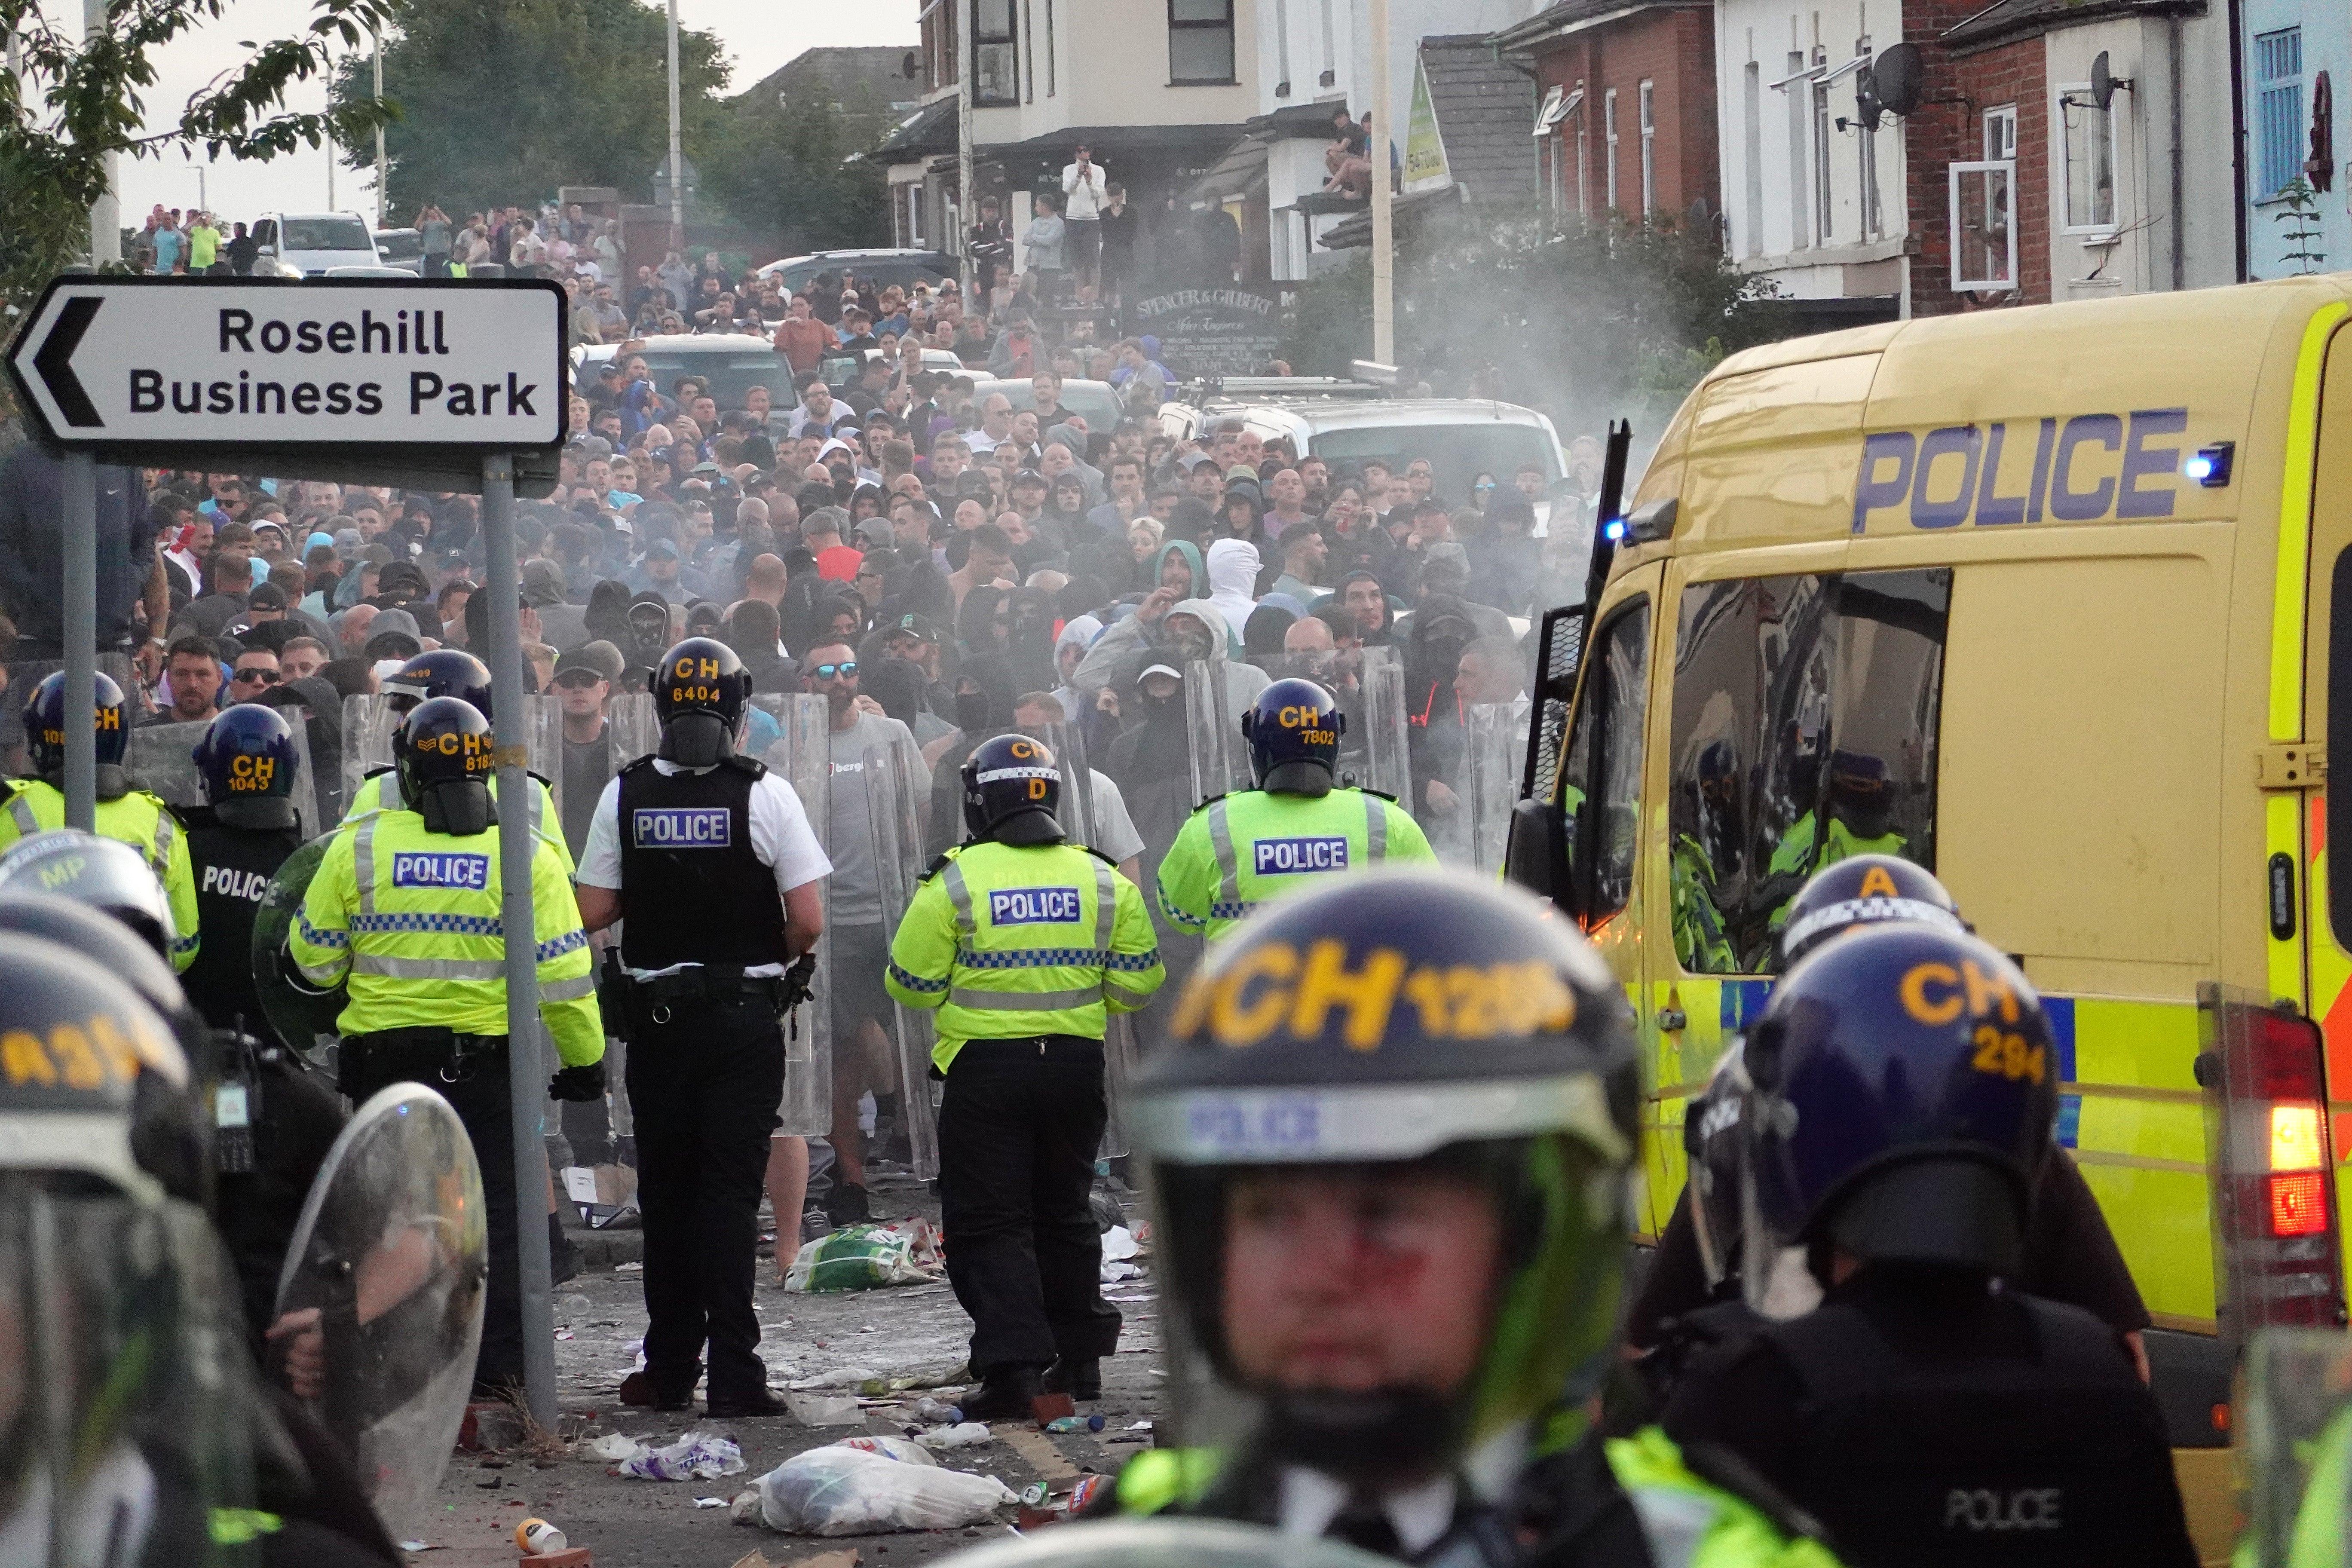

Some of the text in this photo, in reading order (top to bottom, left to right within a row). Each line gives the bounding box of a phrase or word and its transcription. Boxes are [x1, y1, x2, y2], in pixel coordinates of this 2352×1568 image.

[219, 309, 450, 355] Rosehill
[129, 369, 538, 417] Business Park
[1852, 407, 2189, 534] POLICE
[675, 657, 719, 681] CH
[673, 686, 720, 702] 6404
[1279, 706, 1318, 728] CH
[438, 732, 480, 756] CH
[1302, 729, 1335, 745] 7802
[1011, 742, 1048, 761] CH
[233, 755, 275, 778] CH
[228, 776, 269, 791] 1043
[1029, 778, 1046, 799] D
[637, 815, 724, 841] POLICE
[1258, 842, 1344, 870] POLICE
[39, 857, 86, 889] MP
[396, 857, 484, 885] POLICE
[1860, 867, 1898, 897] A
[203, 866, 280, 906] POLICE
[992, 892, 1077, 919] POLICE
[1208, 938, 1409, 1052] CH
[1900, 960, 2020, 1027] CH
[1945, 1488, 2061, 1531] POLICE
